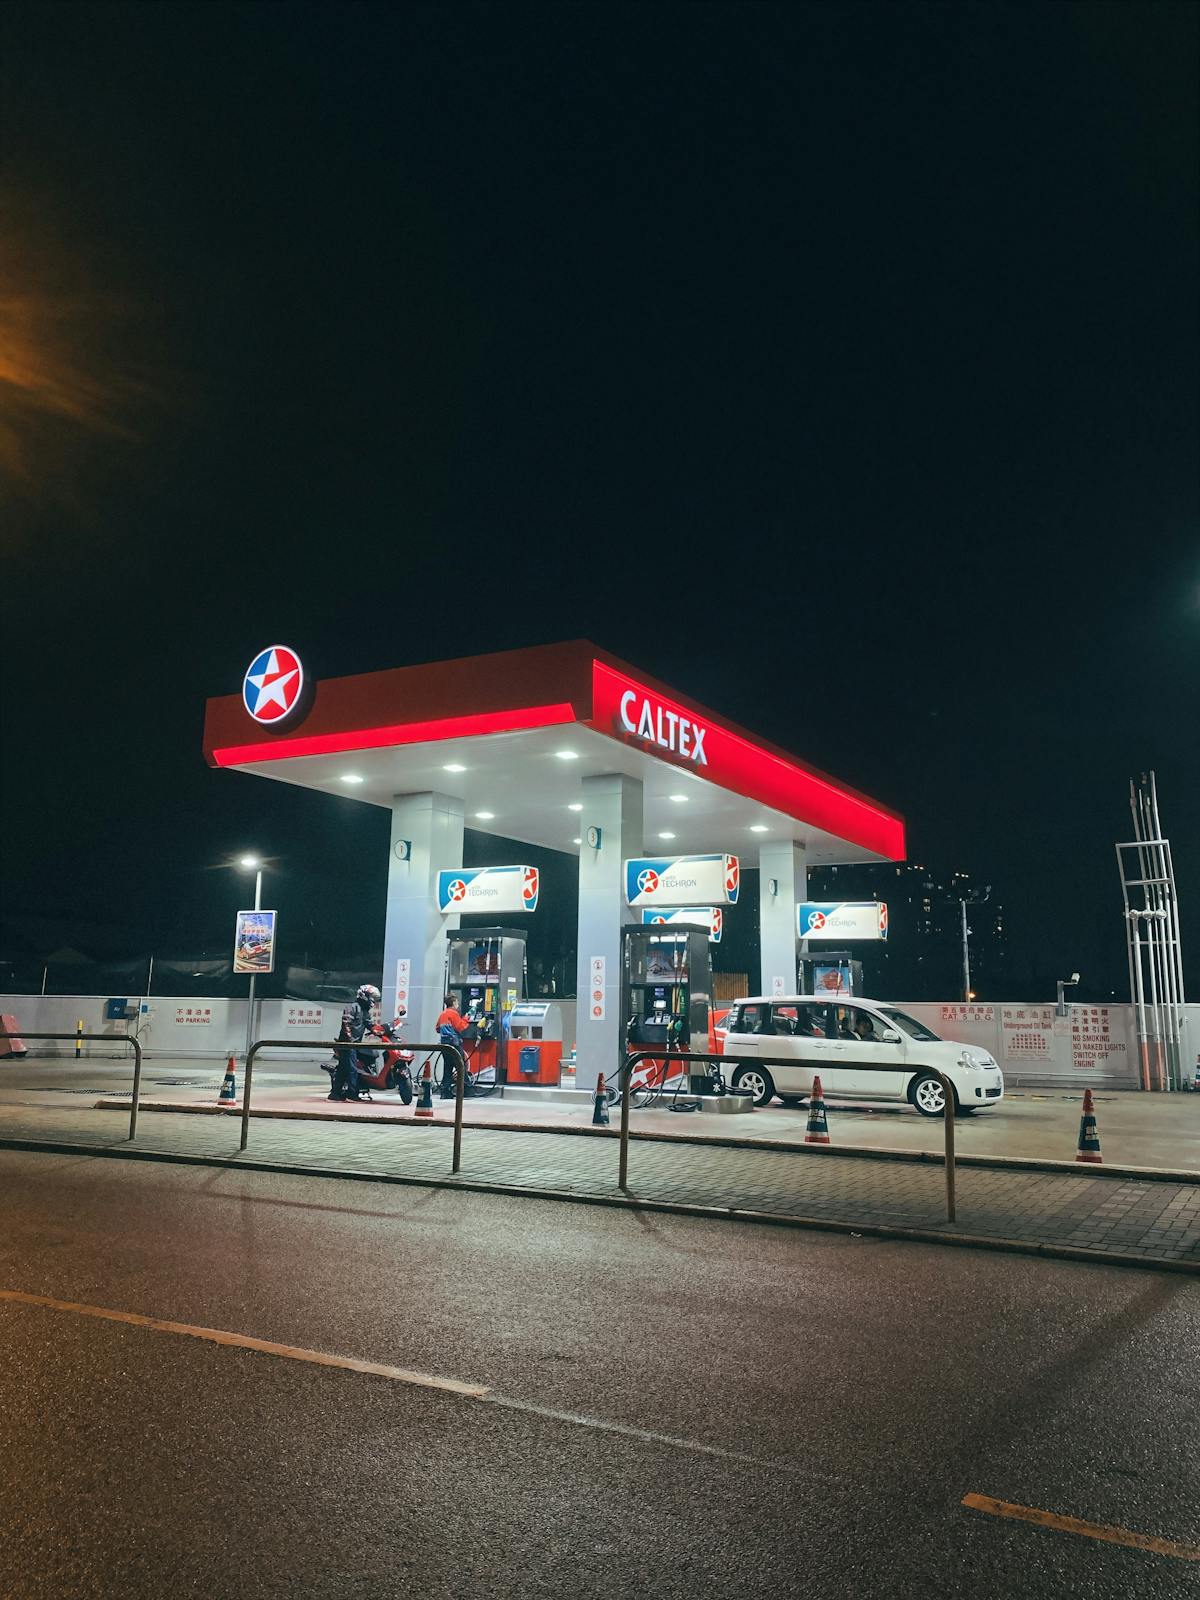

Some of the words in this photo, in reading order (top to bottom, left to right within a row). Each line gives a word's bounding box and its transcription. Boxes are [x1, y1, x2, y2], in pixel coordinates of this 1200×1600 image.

[620, 690, 707, 765] CALTEX
[662, 879, 697, 888] TECHRON
[1072, 1034, 1081, 1042] NO
[1082, 1034, 1110, 1042] SMOKING
[1083, 1043, 1103, 1051] NAKED
[1104, 1043, 1126, 1051] LIGHTS
[1073, 1051, 1097, 1059] SWITCH
[1097, 1052, 1109, 1060] OFF
[1074, 1060, 1096, 1068] ENGINE
